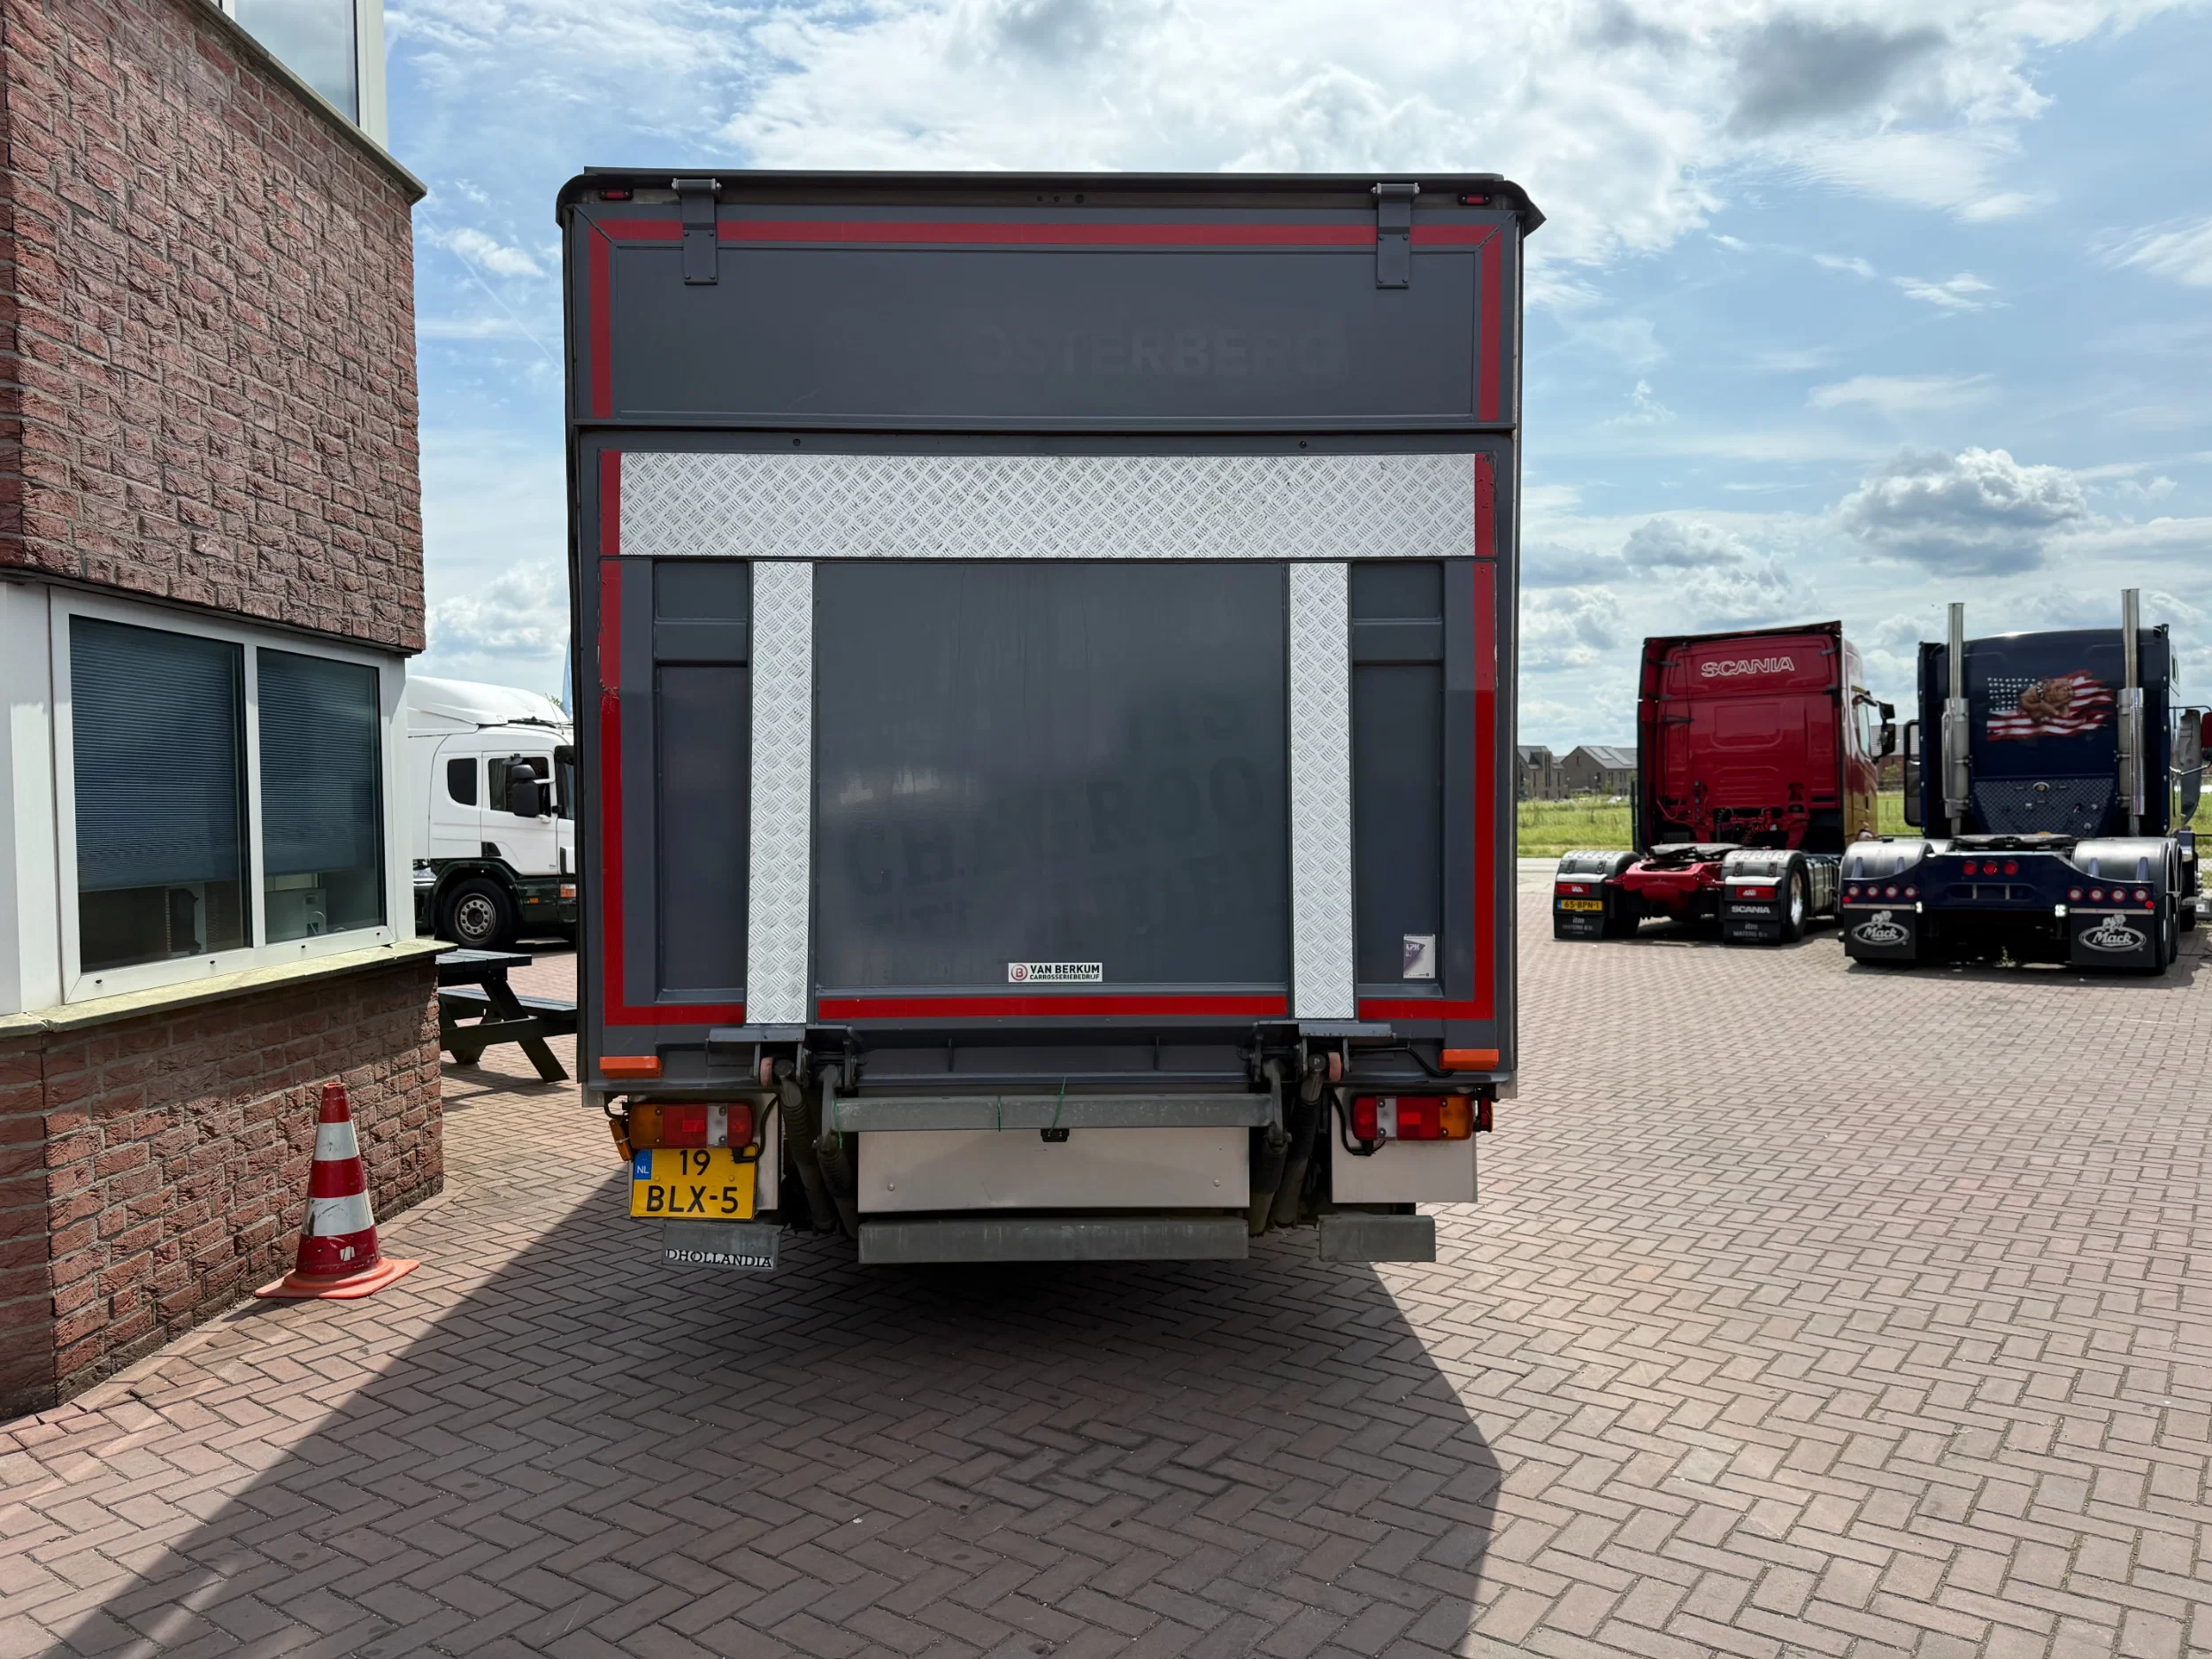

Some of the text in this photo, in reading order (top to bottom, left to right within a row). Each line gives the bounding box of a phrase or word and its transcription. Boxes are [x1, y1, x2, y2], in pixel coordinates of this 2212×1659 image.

[1701, 657, 1795, 677] SCANIA
[1732, 905, 1770, 914] SCANIA
[1863, 926, 1899, 941] Mack
[2092, 931, 2133, 946] Mack
[1030, 964, 1100, 974] VAN BERKUM
[636, 1165, 649, 1174] NL
[680, 1150, 710, 1176] 19
[646, 1186, 739, 1213] BLX-5
[665, 1248, 772, 1268] DHOLLANDIA
